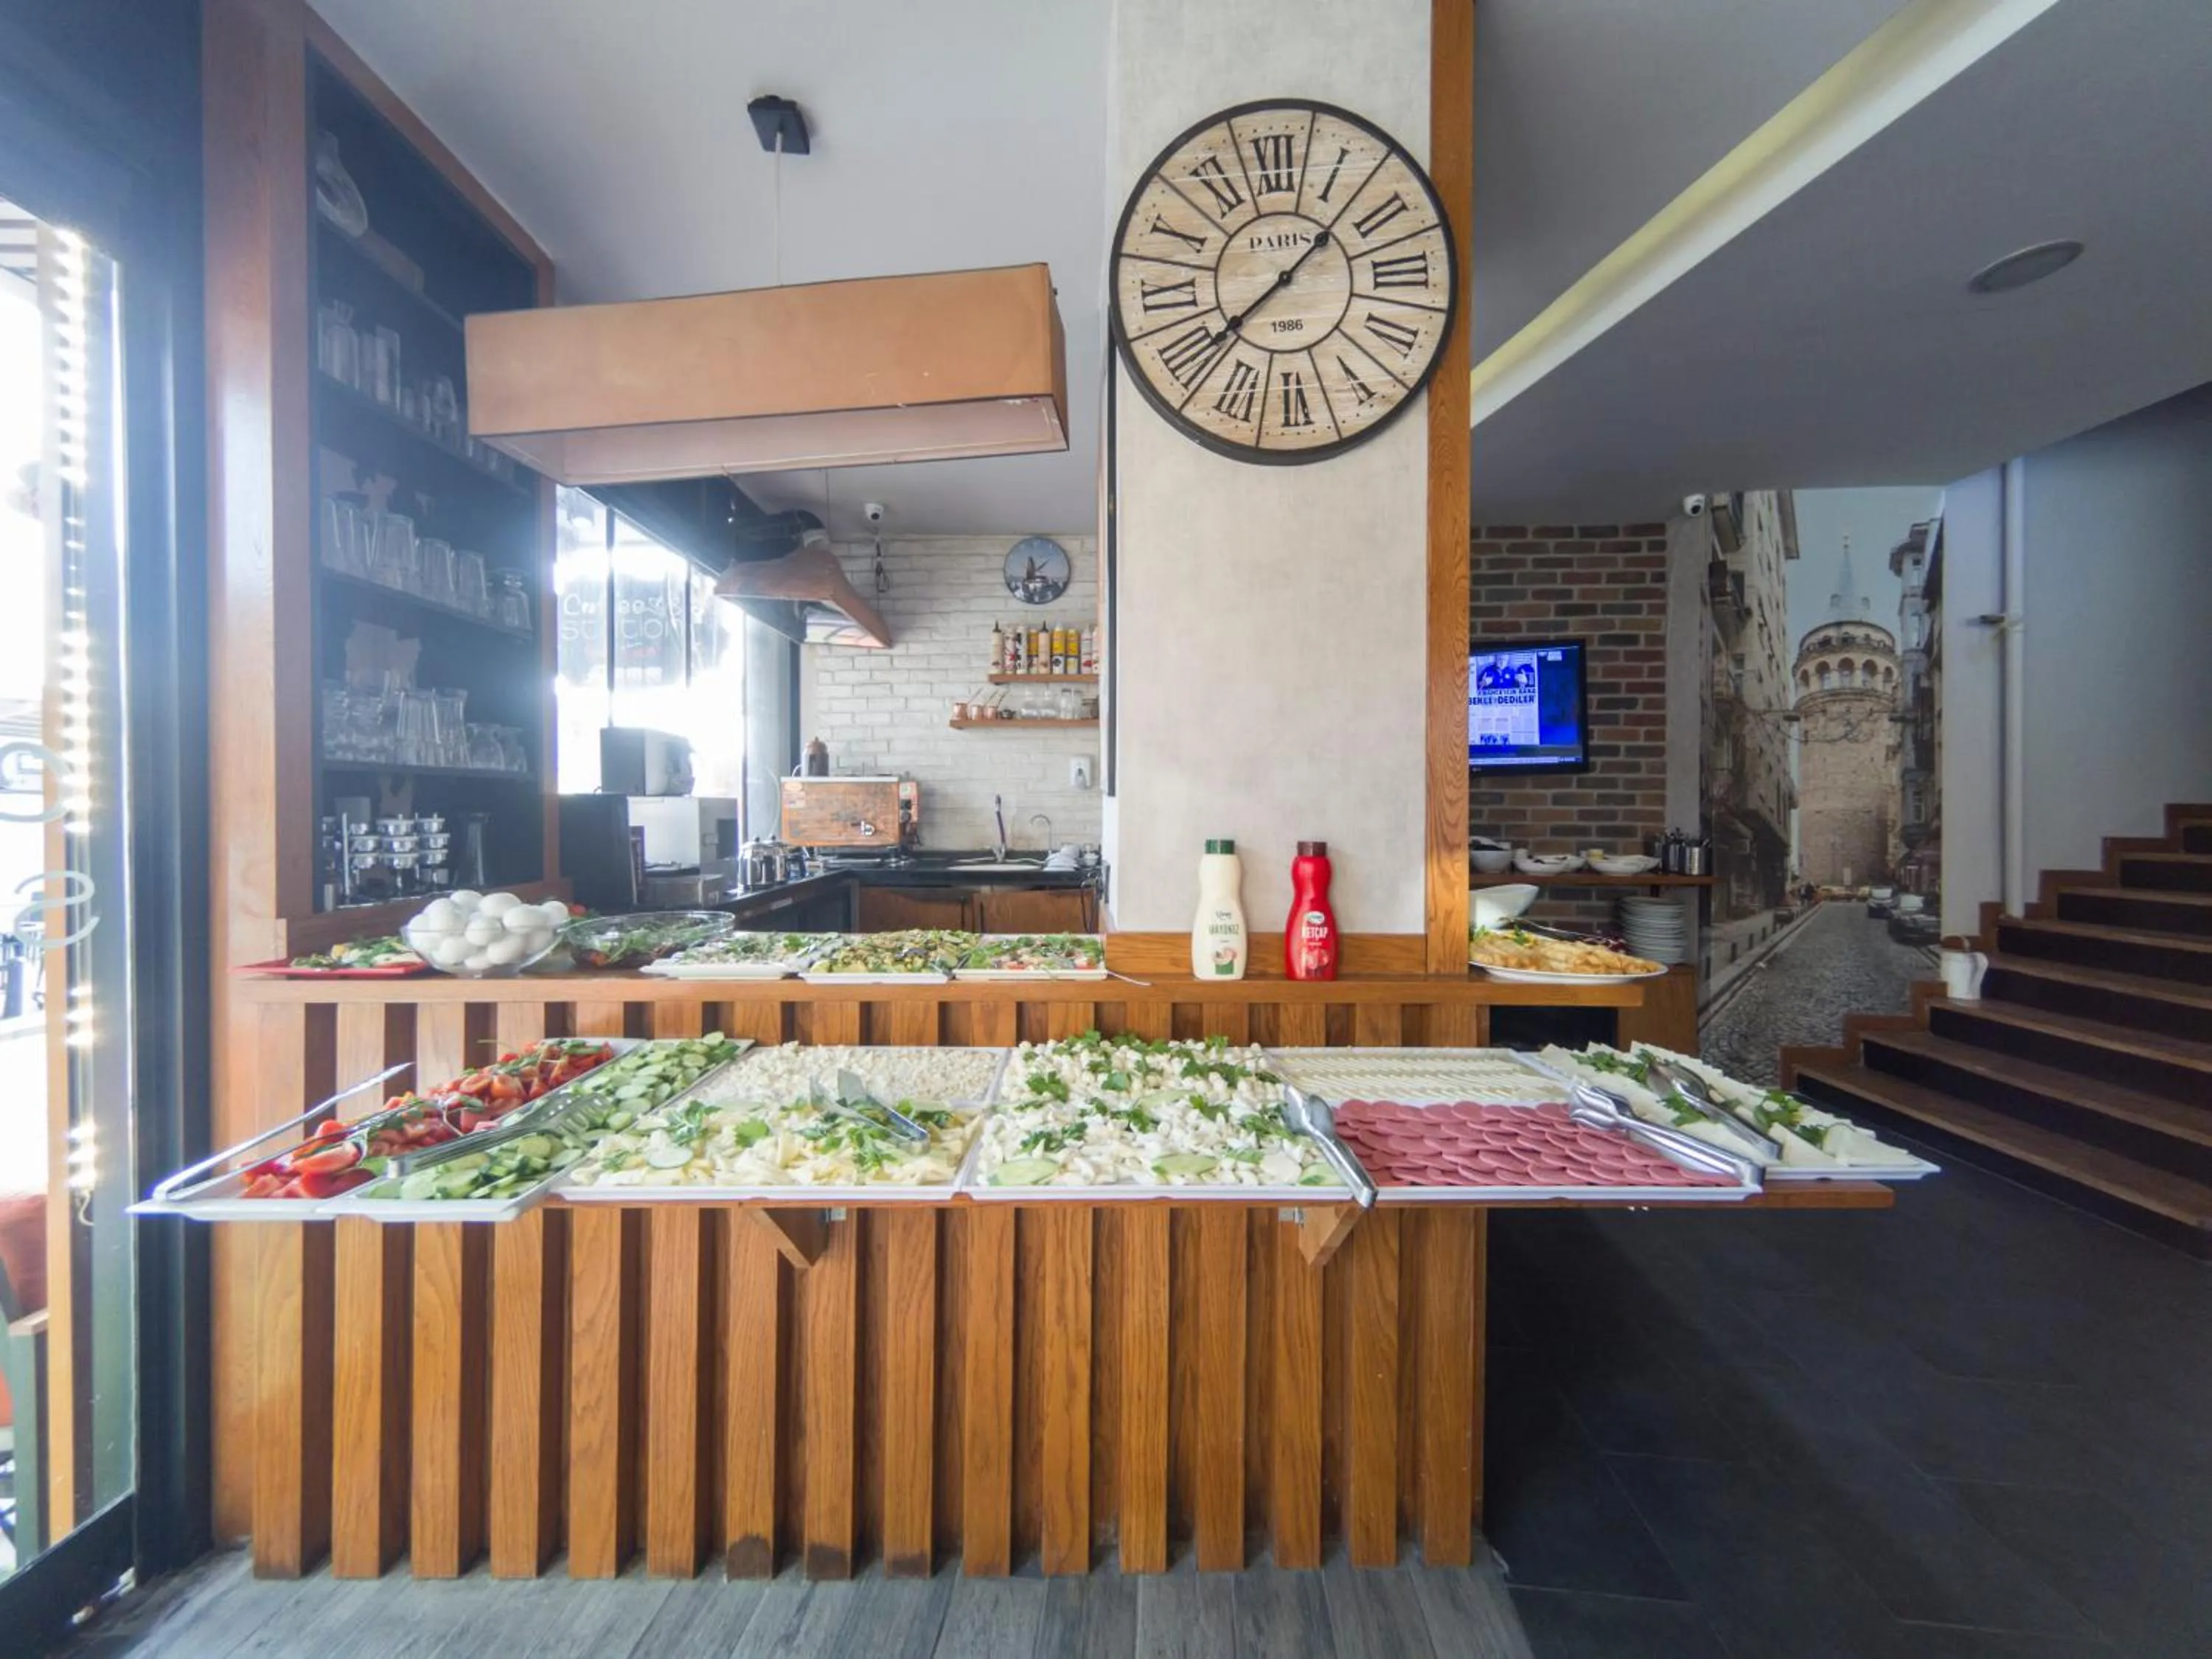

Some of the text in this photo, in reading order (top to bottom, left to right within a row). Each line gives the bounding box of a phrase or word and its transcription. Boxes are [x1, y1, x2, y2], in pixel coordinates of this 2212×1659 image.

[1189, 155, 1245, 219] XI
[1249, 134, 1295, 197] XII
[1150, 214, 1207, 253] X
[1353, 192, 1410, 238] II
[1249, 232, 1312, 250] PARIS
[1371, 251, 1429, 290] III
[1141, 278, 1198, 312] IX
[1271, 319, 1304, 333] 1986
[1365, 313, 1419, 359] IV
[1213, 359, 1260, 422] VII
[1281, 372, 1313, 428] VI
[1336, 355, 1377, 406] V
